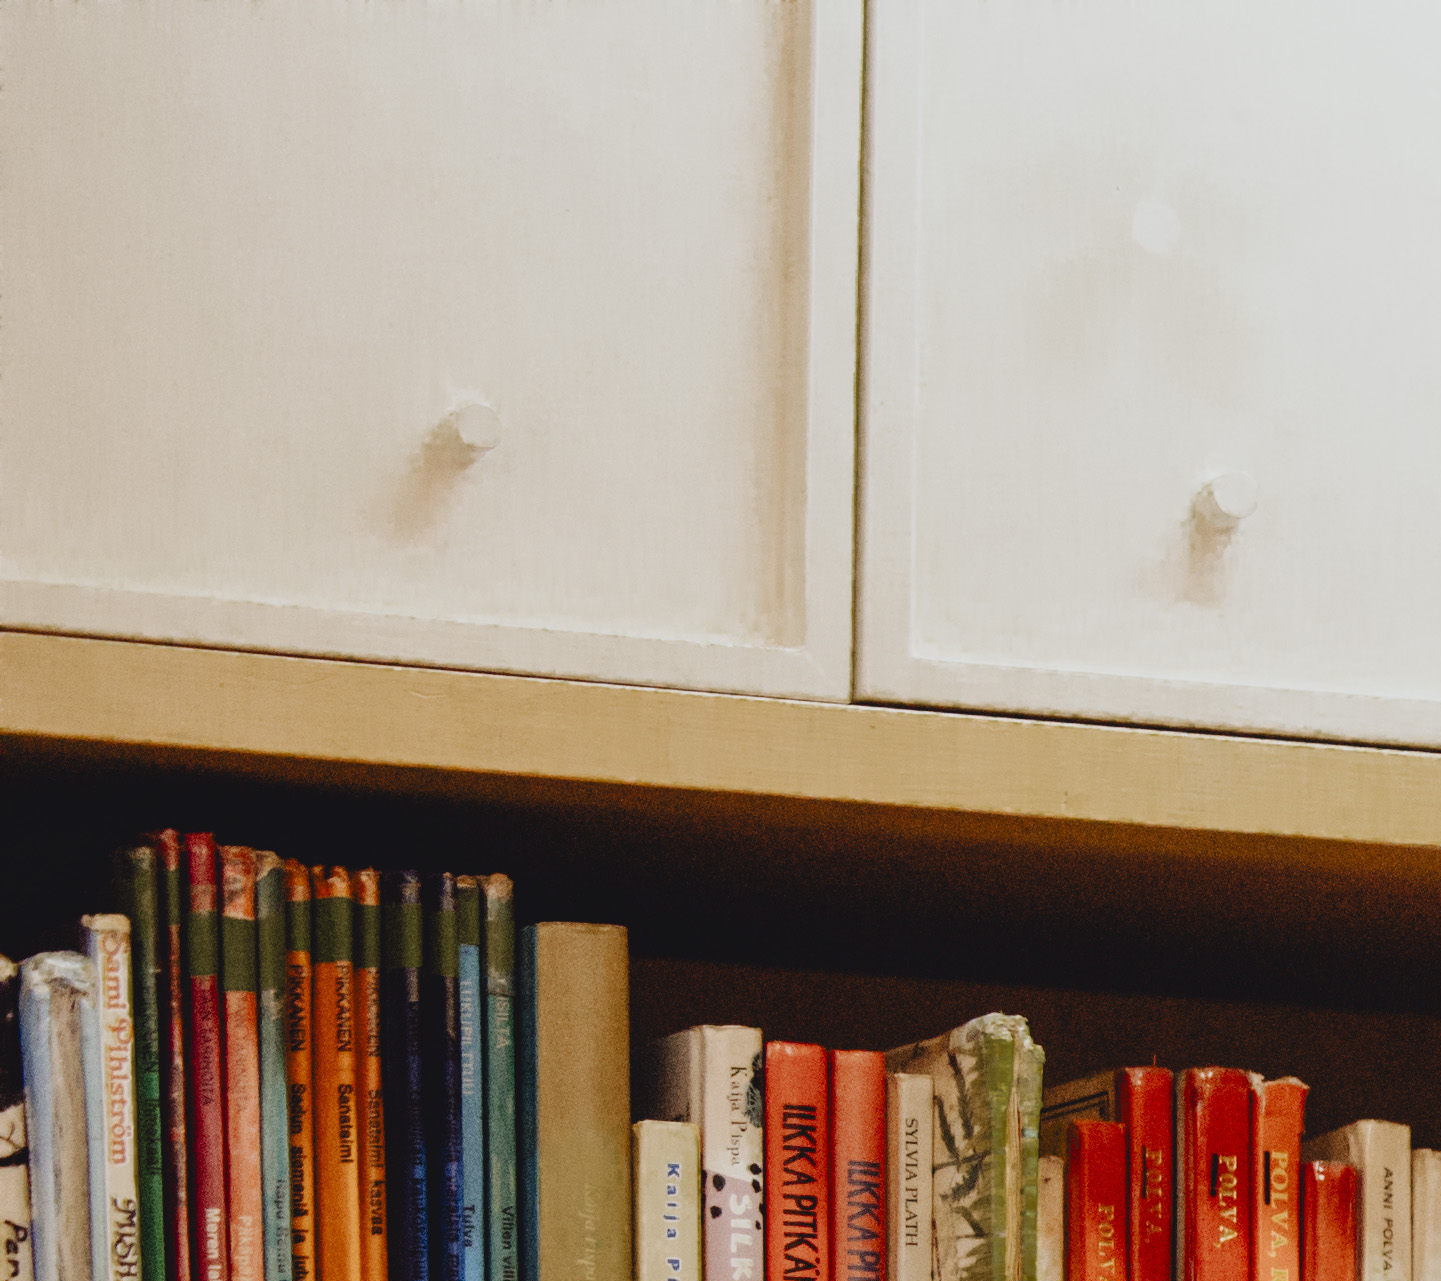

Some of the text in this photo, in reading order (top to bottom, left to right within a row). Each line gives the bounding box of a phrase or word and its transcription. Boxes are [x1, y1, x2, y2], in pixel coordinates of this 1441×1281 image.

[102, 930, 134, 1165] Sami Pihlström
[290, 1083, 308, 1134] Sadun
[727, 1065, 749, 1112] Kaija
[337, 1083, 355, 1163] Sanataimi
[727, 1120, 749, 1166] Pispa
[782, 1103, 818, 1187] ILKKA
[904, 1117, 920, 1181] SYLVIA
[370, 1179, 386, 1236] kasvaa
[662, 1162, 681, 1239] Kaija
[847, 1160, 882, 1243] ILKKA
[1381, 1166, 1395, 1210] ANNI
[206, 1207, 221, 1260] Meren
[292, 1229, 309, 1244] ja
[462, 1204, 476, 1248] Tulva
[502, 1206, 515, 1249] Villen
[904, 1186, 920, 1247] PLATH
[1381, 1217, 1395, 1272] POLVA
